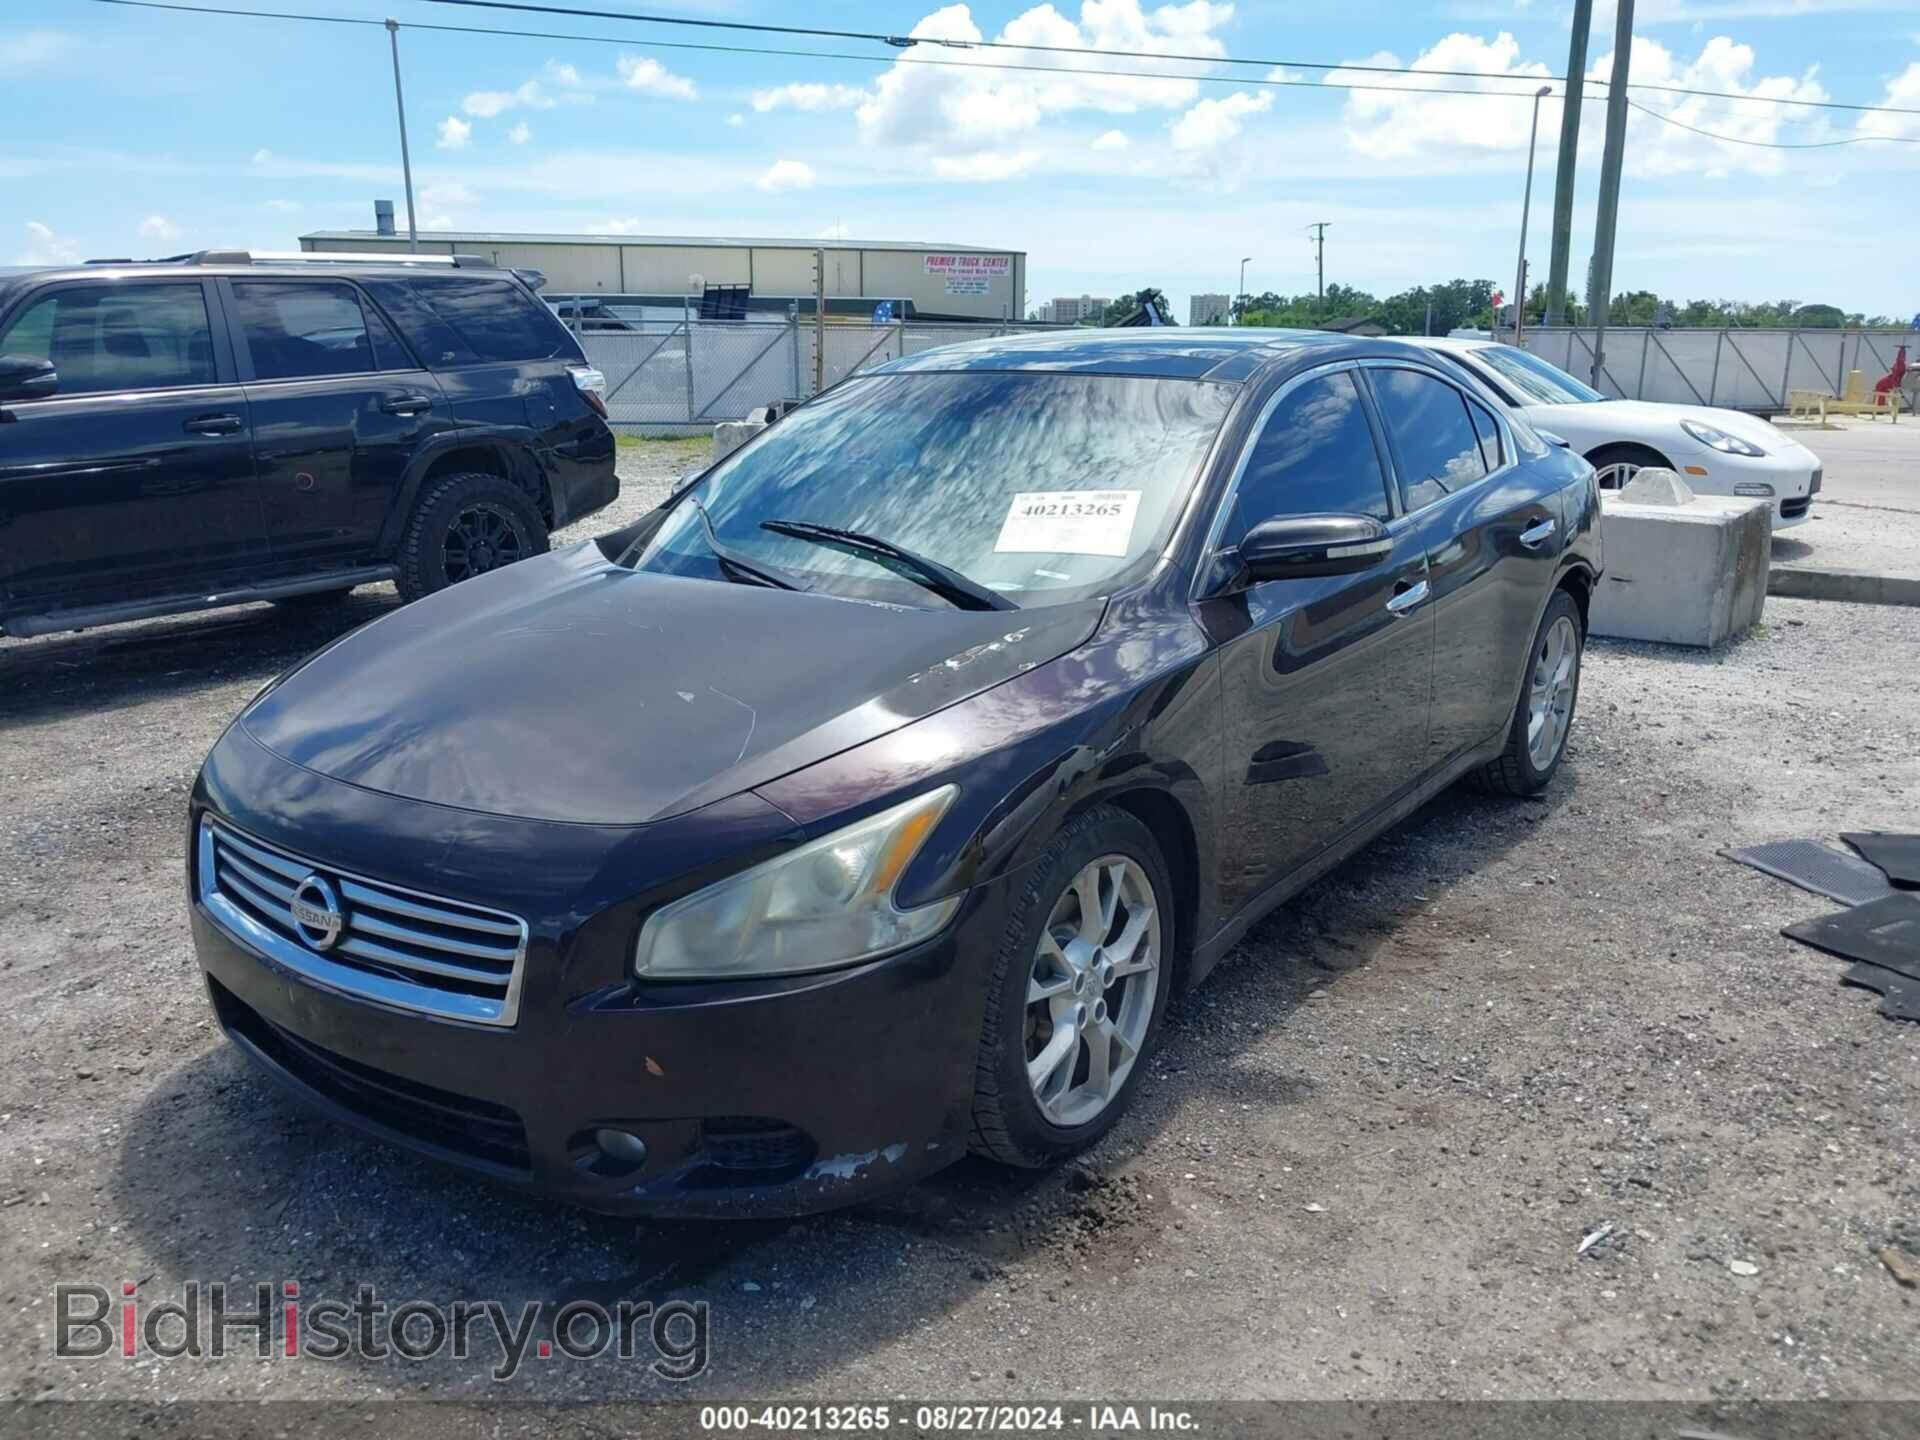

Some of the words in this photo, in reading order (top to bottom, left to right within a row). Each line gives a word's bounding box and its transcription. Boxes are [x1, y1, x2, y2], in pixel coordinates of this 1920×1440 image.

[926, 256, 956, 266] PREMIER
[958, 256, 981, 267] TRUCK
[982, 257, 1009, 268] CENTER
[1020, 503, 1123, 517] 40213265
